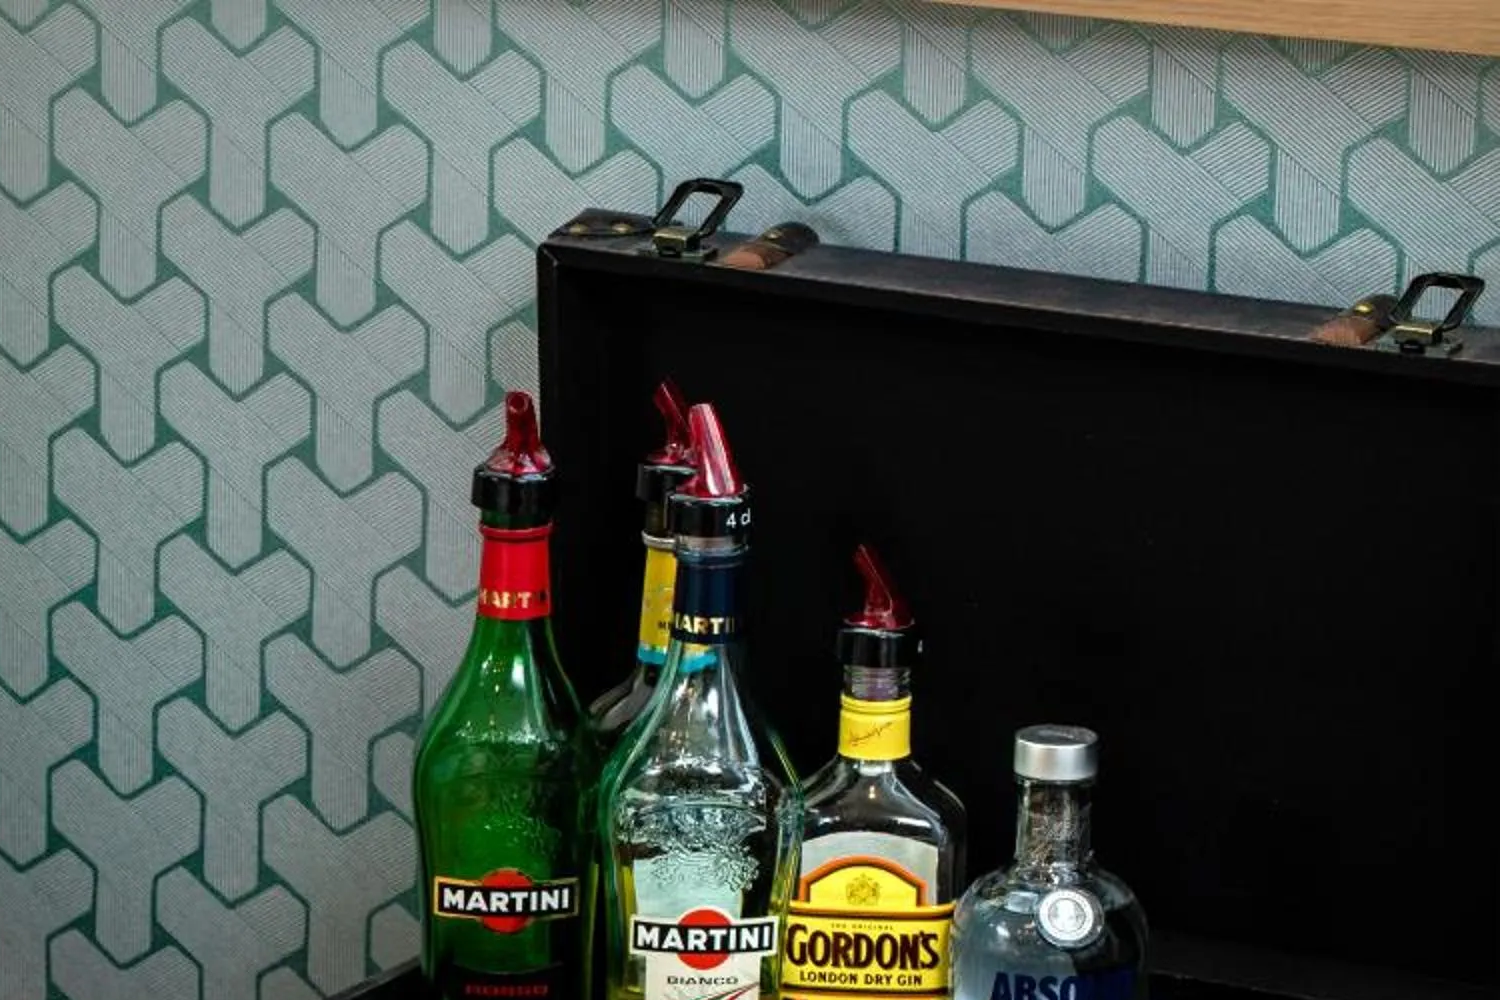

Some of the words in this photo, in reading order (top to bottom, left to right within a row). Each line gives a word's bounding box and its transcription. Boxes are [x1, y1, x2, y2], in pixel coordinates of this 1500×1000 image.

[726, 511, 737, 529] 4
[442, 887, 570, 913] MARTINI
[636, 924, 772, 952] MARTINI
[785, 923, 941, 971] GORDON'S
[666, 975, 740, 986] BIANCO
[800, 971, 859, 985] LONDON
[864, 974, 893, 986] DRY
[897, 974, 924, 986] GIN
